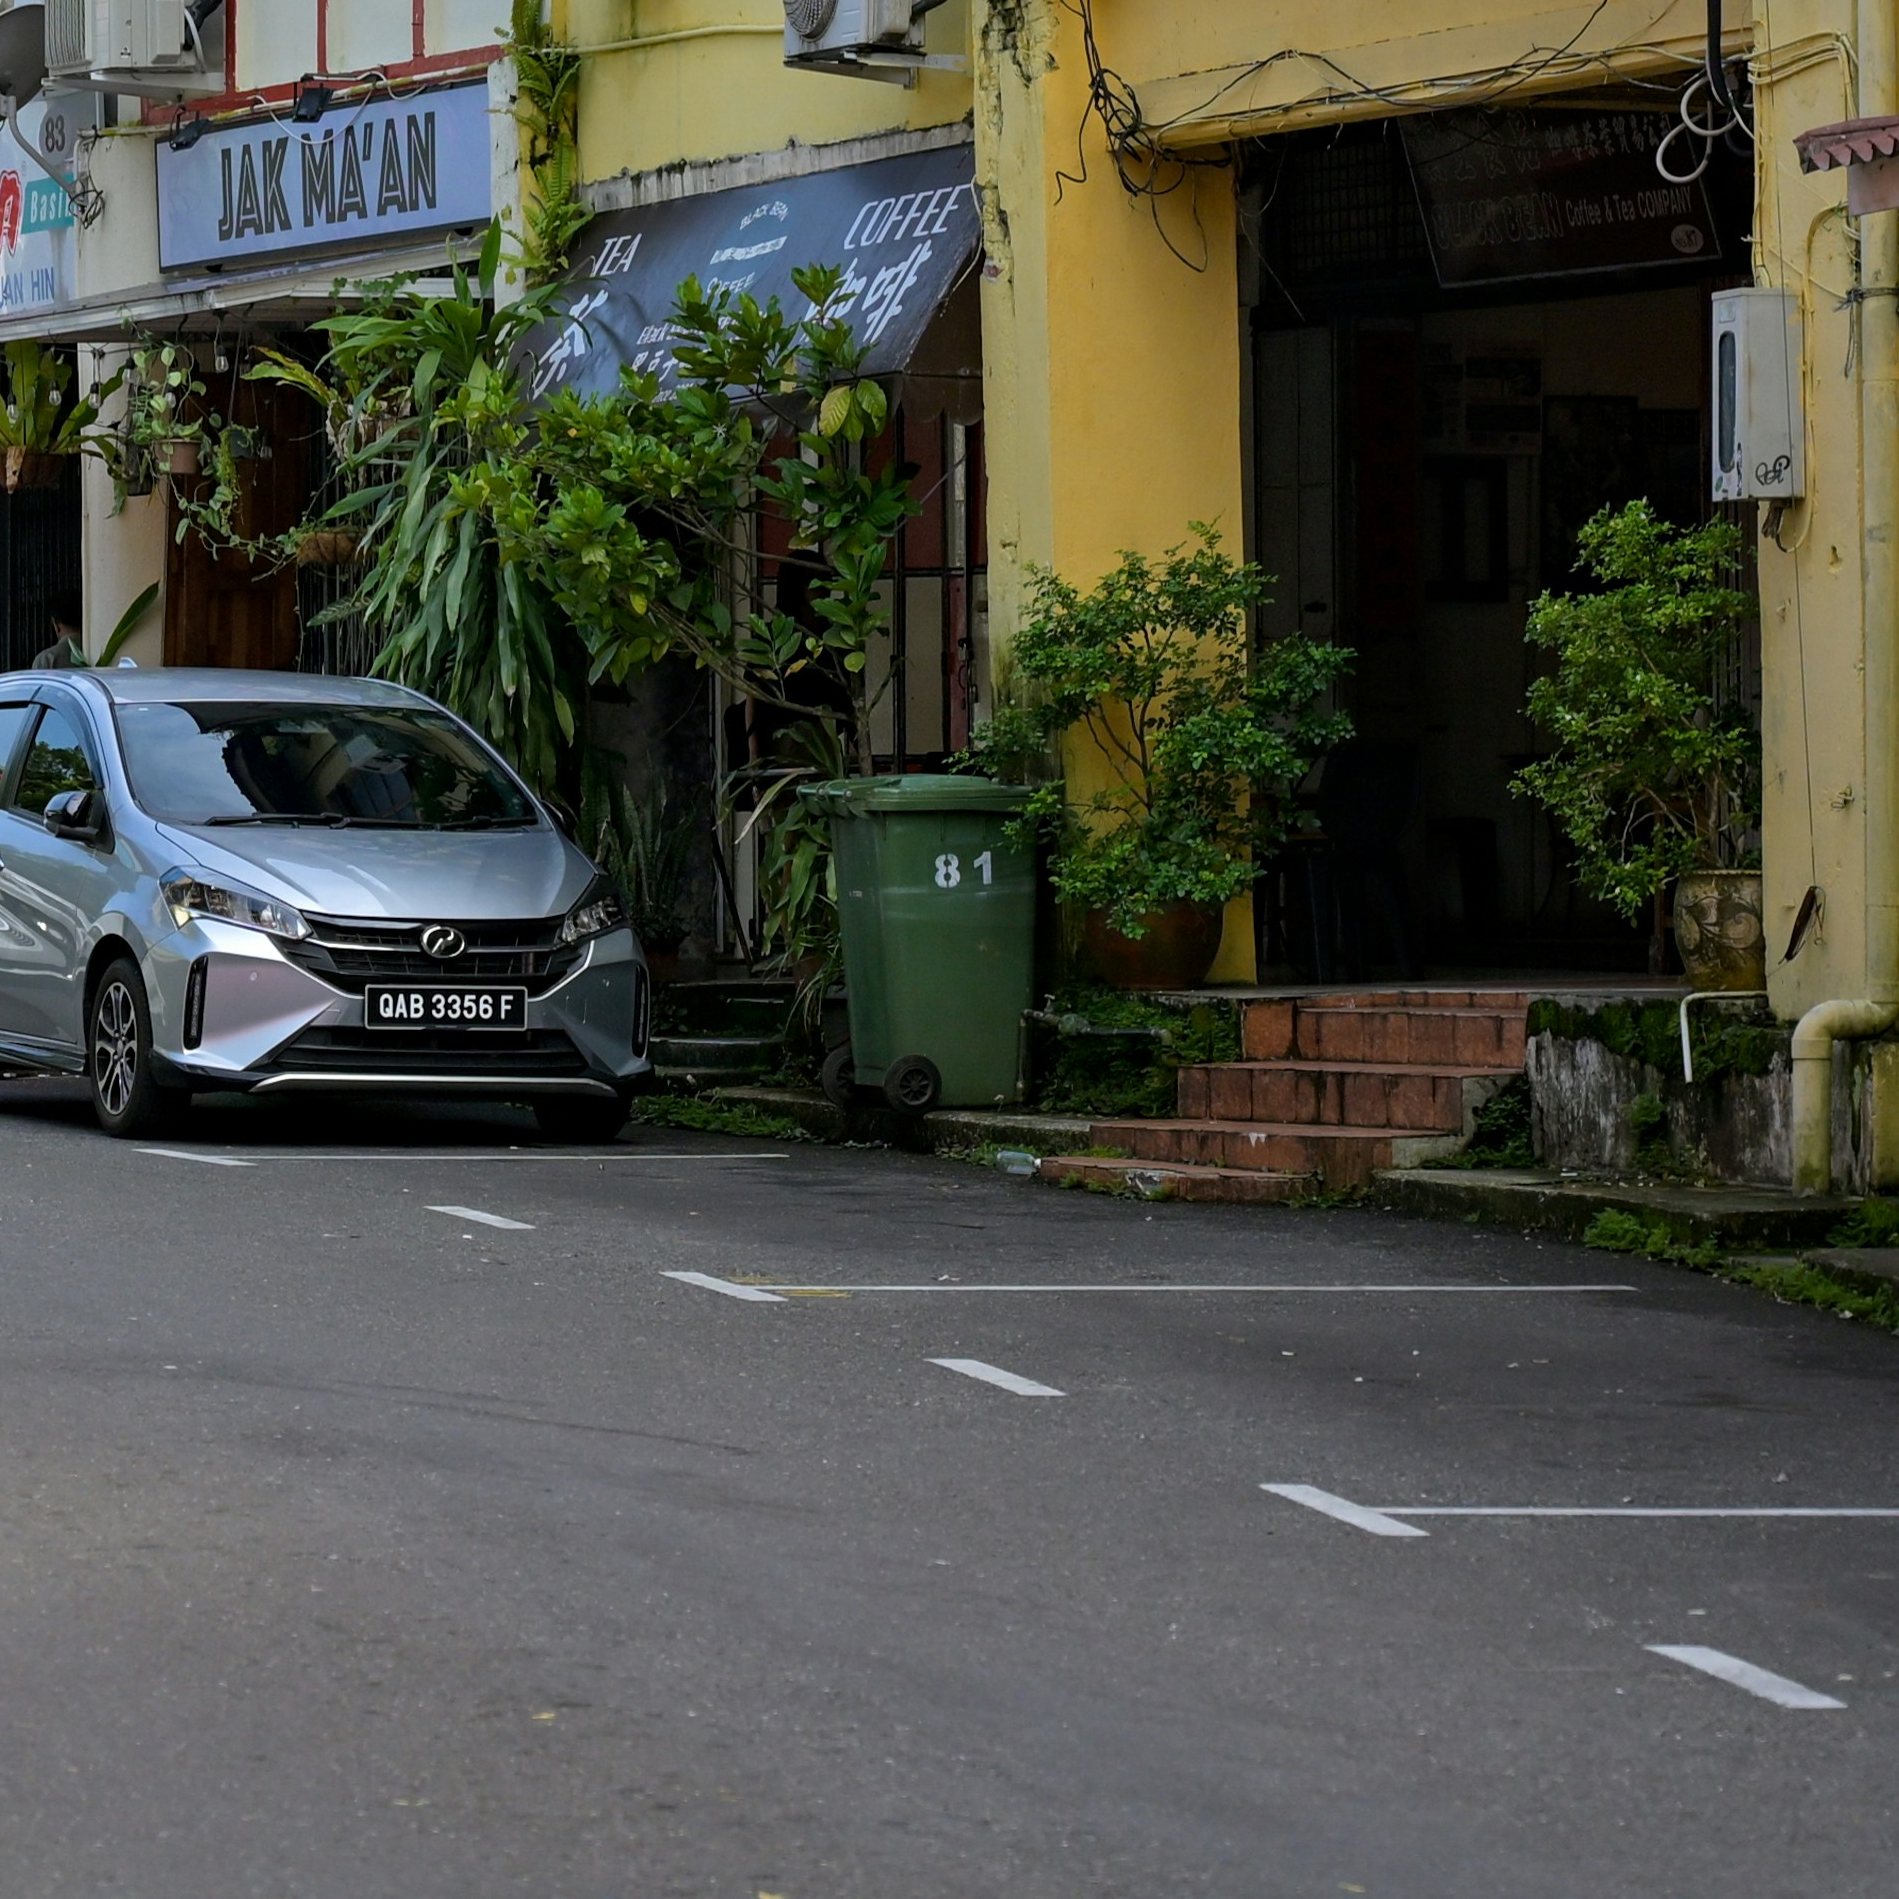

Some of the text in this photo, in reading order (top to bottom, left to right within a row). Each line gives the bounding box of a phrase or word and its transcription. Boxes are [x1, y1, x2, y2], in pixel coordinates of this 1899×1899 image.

[44, 114, 65, 152] 83
[218, 111, 437, 242] JAK MA'AN
[843, 183, 972, 250] COFFEE
[1565, 198, 1602, 227] Coffee
[1612, 194, 1636, 221] Tea
[1637, 185, 1692, 219] COMPANY
[590, 232, 643, 278] TEA
[31, 267, 55, 302] HIN
[934, 851, 993, 888] 81
[379, 993, 514, 1020] QAB 3356 F
